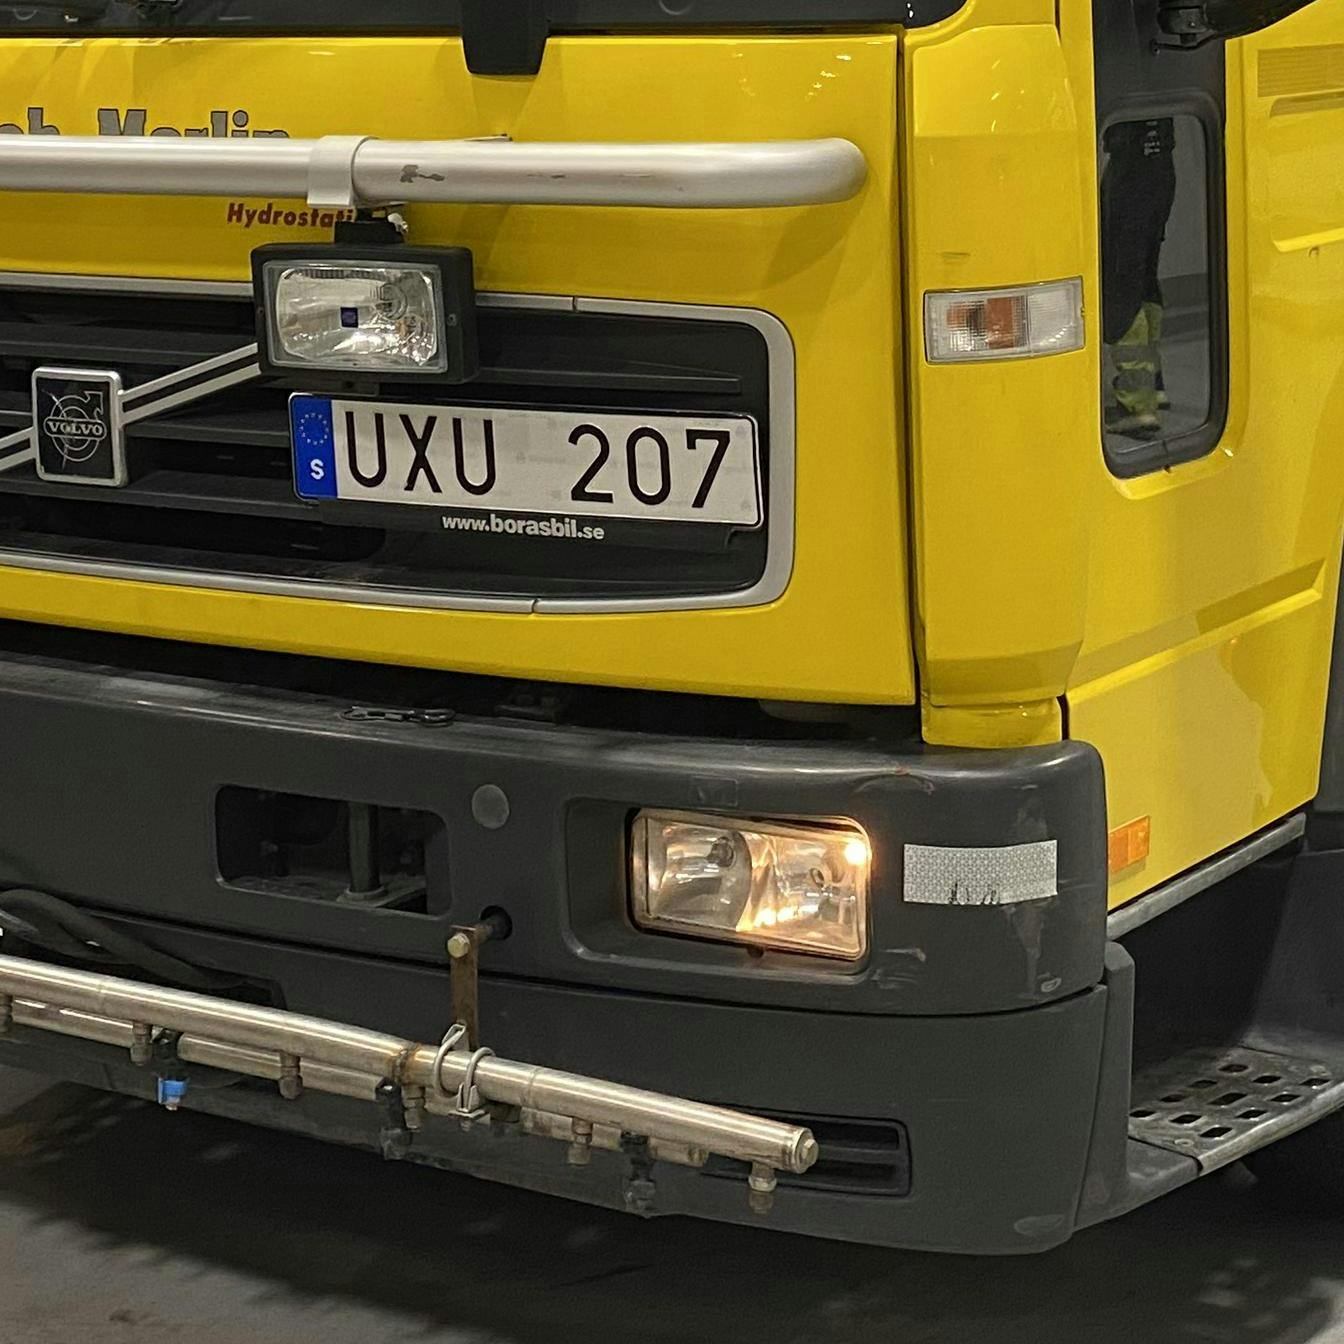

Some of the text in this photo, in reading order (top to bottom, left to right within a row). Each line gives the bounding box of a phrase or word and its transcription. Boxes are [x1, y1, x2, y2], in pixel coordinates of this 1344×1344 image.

[47, 420, 103, 436] VOLVO
[311, 411, 731, 509] S UXU 207
[442, 513, 605, 541] www.borasbil.se
